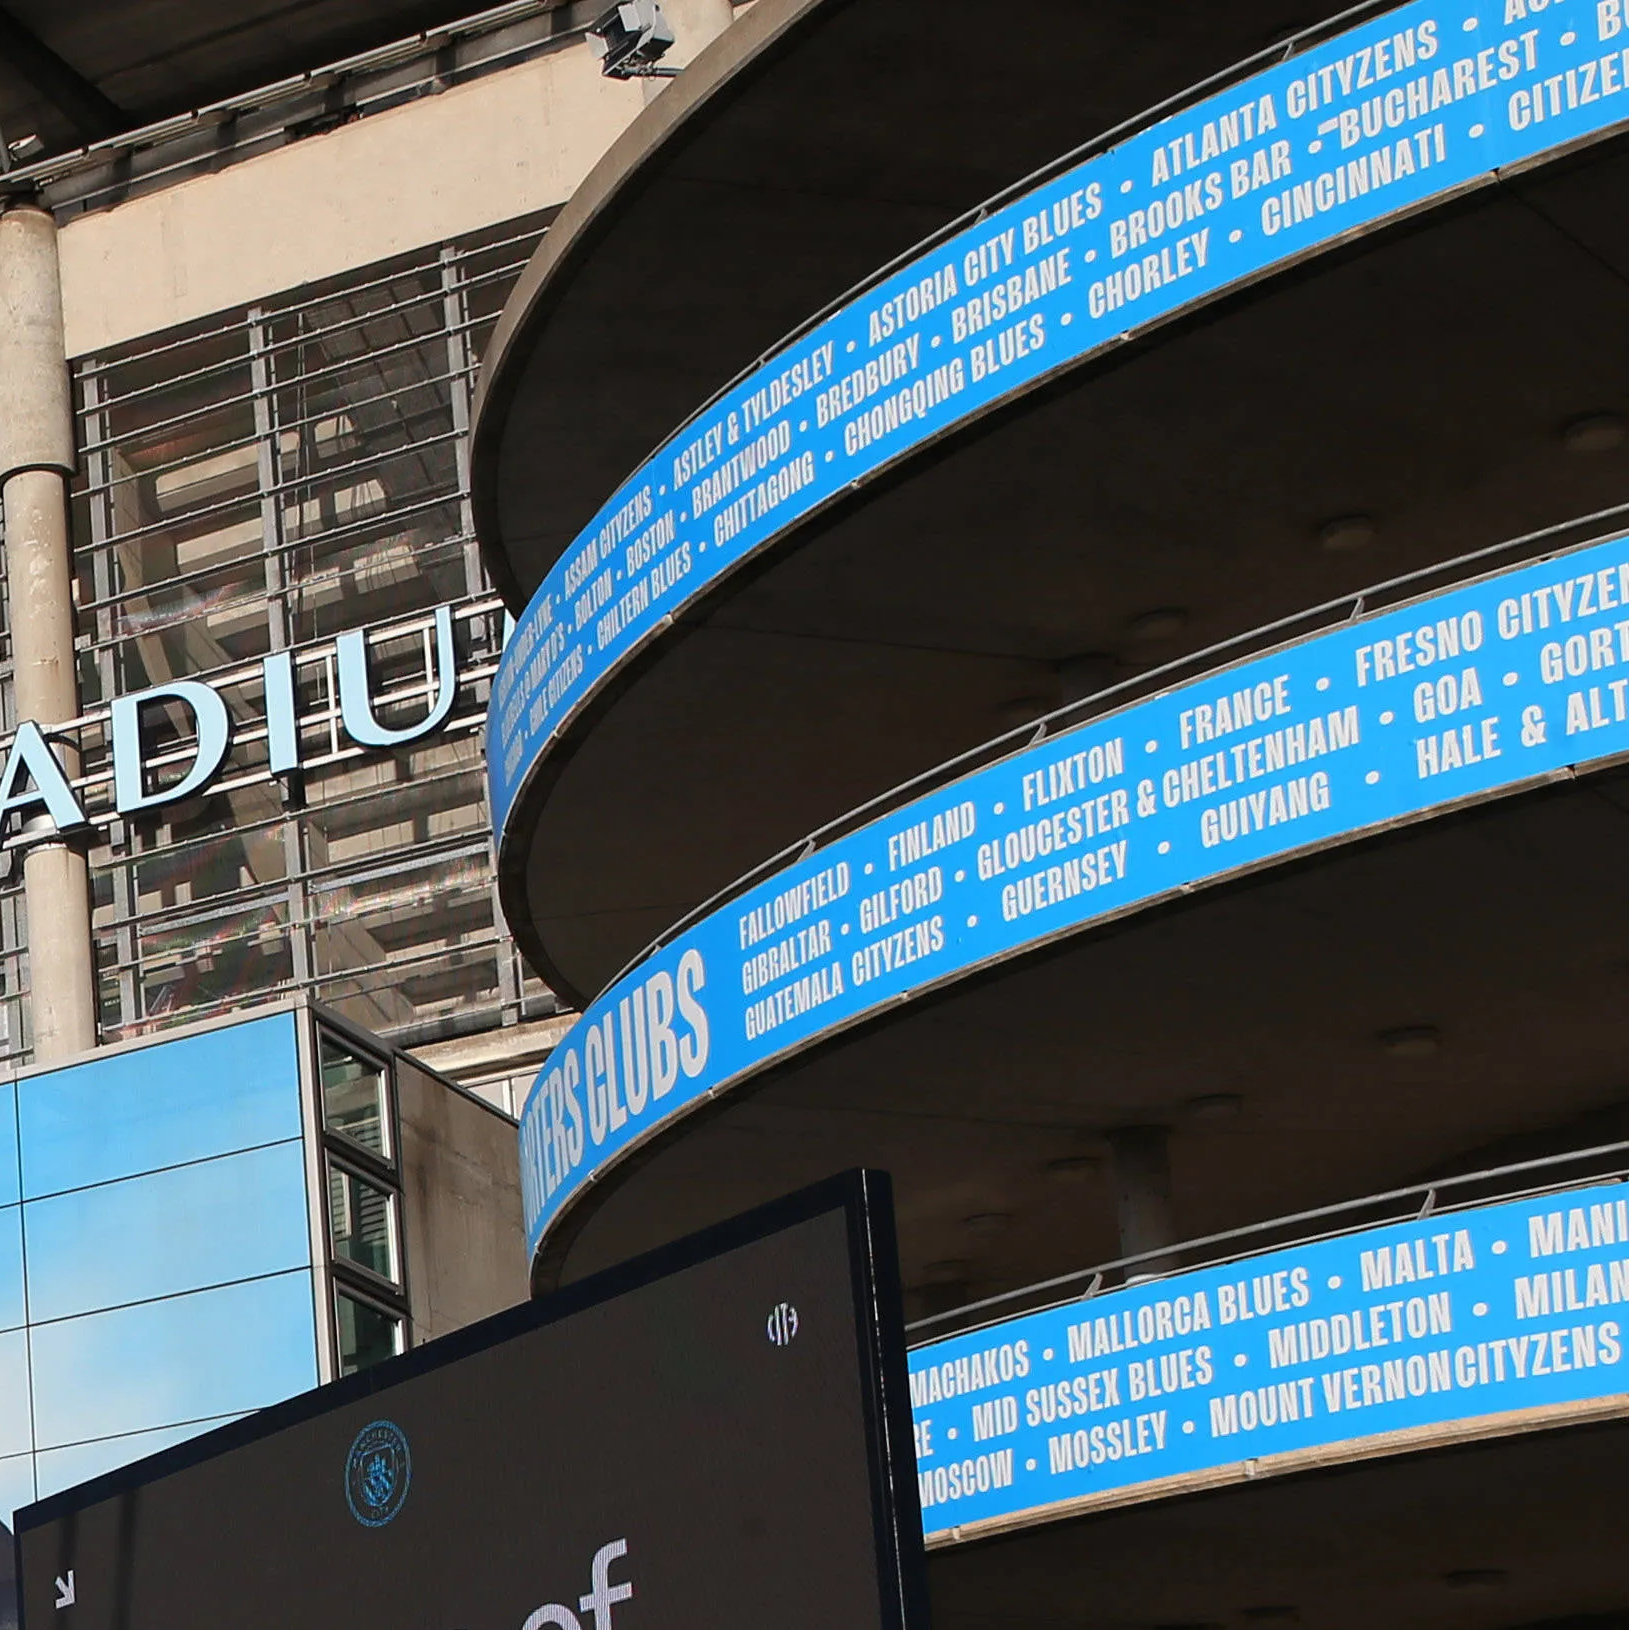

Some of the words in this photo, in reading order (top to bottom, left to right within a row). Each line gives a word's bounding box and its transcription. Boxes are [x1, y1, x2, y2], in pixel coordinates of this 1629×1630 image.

[626, 510, 676, 577] BOSTON
[692, 419, 790, 519] BRANTWOOD
[816, 332, 920, 429] BREDBURY
[951, 248, 1072, 344] BRISBANE
[1109, 172, 1222, 259] BROOKS
[1231, 140, 1292, 200] BAR
[1340, 29, 1539, 150] BUCHAREST
[651, 541, 691, 596] BLUES
[714, 450, 814, 547] CHITTAGONG
[844, 359, 965, 457] CHONGQING
[971, 313, 1044, 383] BLUES
[1087, 228, 1210, 320] CHORLEY
[1261, 123, 1446, 237] CINCINNATI
[674, 422, 723, 490] ASTLEY
[742, 340, 834, 433] TYLDESLEY
[869, 264, 956, 347] ASTORIA
[964, 228, 1015, 286] CITY
[1024, 182, 1102, 253] BLUES
[1151, 94, 1276, 187] ATLANTA
[1286, 19, 1438, 119] CITYZENS
[740, 862, 851, 950] FALLOWFIELD
[888, 801, 975, 871] FINLAND
[1022, 738, 1124, 811] FLIXTON
[1180, 674, 1291, 749] FRANCE
[1355, 611, 1483, 687] FRESNO
[742, 920, 831, 996] GIBRALTAR
[859, 866, 943, 934] GILFORD
[977, 789, 1129, 881] GLOUCESTER
[1162, 706, 1360, 808] CHELTENHAM
[1413, 667, 1483, 724] GOA
[745, 962, 844, 1041] GUATEMALA
[851, 915, 944, 987] CITYZENS
[1002, 840, 1128, 922] GUERNSEY
[1200, 771, 1331, 849] GUIYANG
[1416, 717, 1501, 779] HALE
[585, 948, 710, 1146] CLUBS
[909, 1340, 1030, 1408] MACHAKOS
[1067, 1291, 1211, 1365] MALLORCA
[1219, 1266, 1310, 1326] BLUES
[1360, 1228, 1476, 1292] MALTA
[918, 1448, 1013, 1508] MOSCOW
[1049, 1410, 1167, 1474] MOSSLEY
[1209, 1377, 1314, 1438] MOUNT
[1321, 1353, 1450, 1414] VERNON
[1456, 1322, 1621, 1391] CITYZENS
[972, 1396, 1018, 1442] MID
[1026, 1369, 1121, 1427] SUSSEX
[1129, 1346, 1214, 1401] BLUES
[1268, 1292, 1452, 1368] MIDDLETON
